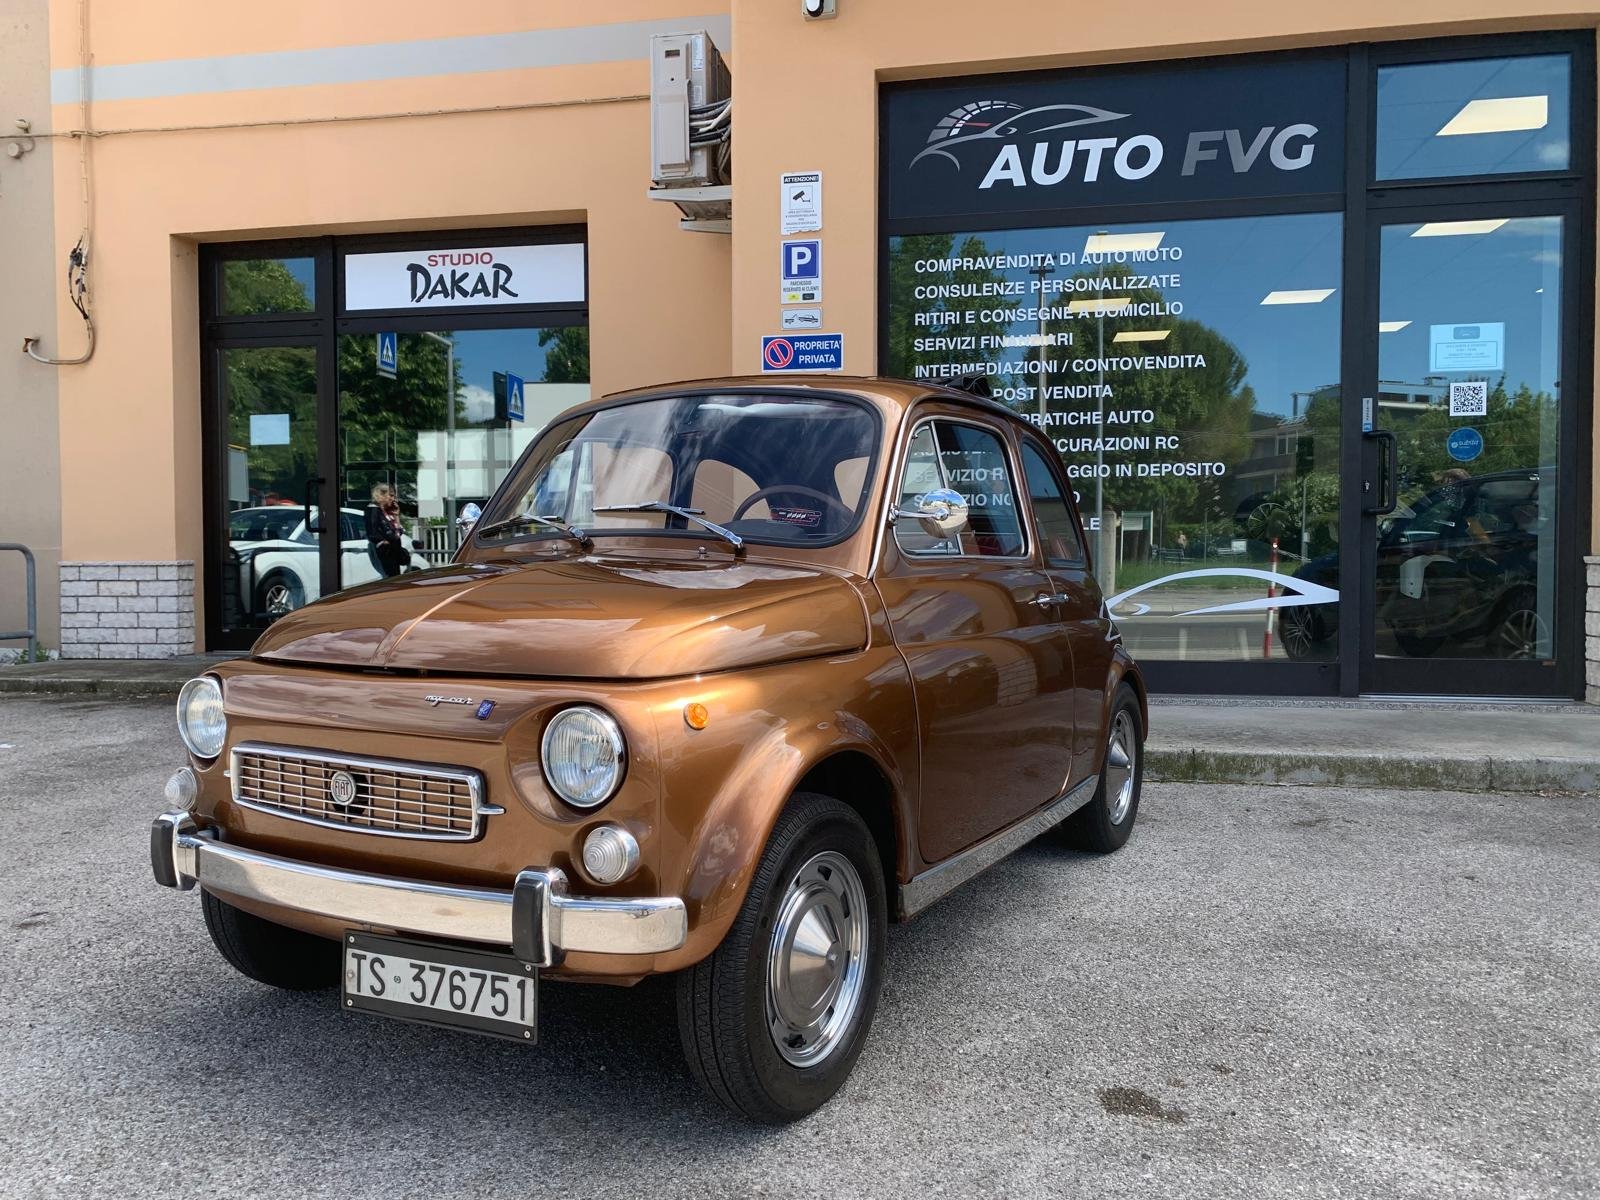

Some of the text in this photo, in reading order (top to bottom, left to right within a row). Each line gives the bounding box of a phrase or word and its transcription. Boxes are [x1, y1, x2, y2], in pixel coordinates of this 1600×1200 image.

[979, 123, 1318, 189] AUTO FVG
[428, 252, 493, 267] STUDIO
[791, 246, 812, 275] P
[915, 246, 1182, 273] COMPRAVENDITA DI AUTO MOTO
[406, 263, 519, 303] DAKAR
[915, 274, 1180, 299] CONSULENZE PERSONALIZZATE
[914, 301, 1183, 326] RITIRI E CONSEGNE A DOMICILIO
[794, 340, 842, 351] PROPRIETA'
[914, 337, 975, 352] SERVIZI
[799, 354, 836, 364] PRIVATA
[915, 354, 1206, 378] INTERMEDIAZIONI / CONTOVENDITA
[993, 384, 1114, 401] POST VENDITA
[1107, 409, 1155, 424] AUTO
[1053, 435, 1179, 452] CURAZIONI RC
[1115, 464, 1132, 477] IN
[1137, 462, 1226, 477] DEPOSITO
[352, 953, 526, 1021] TS 376751
